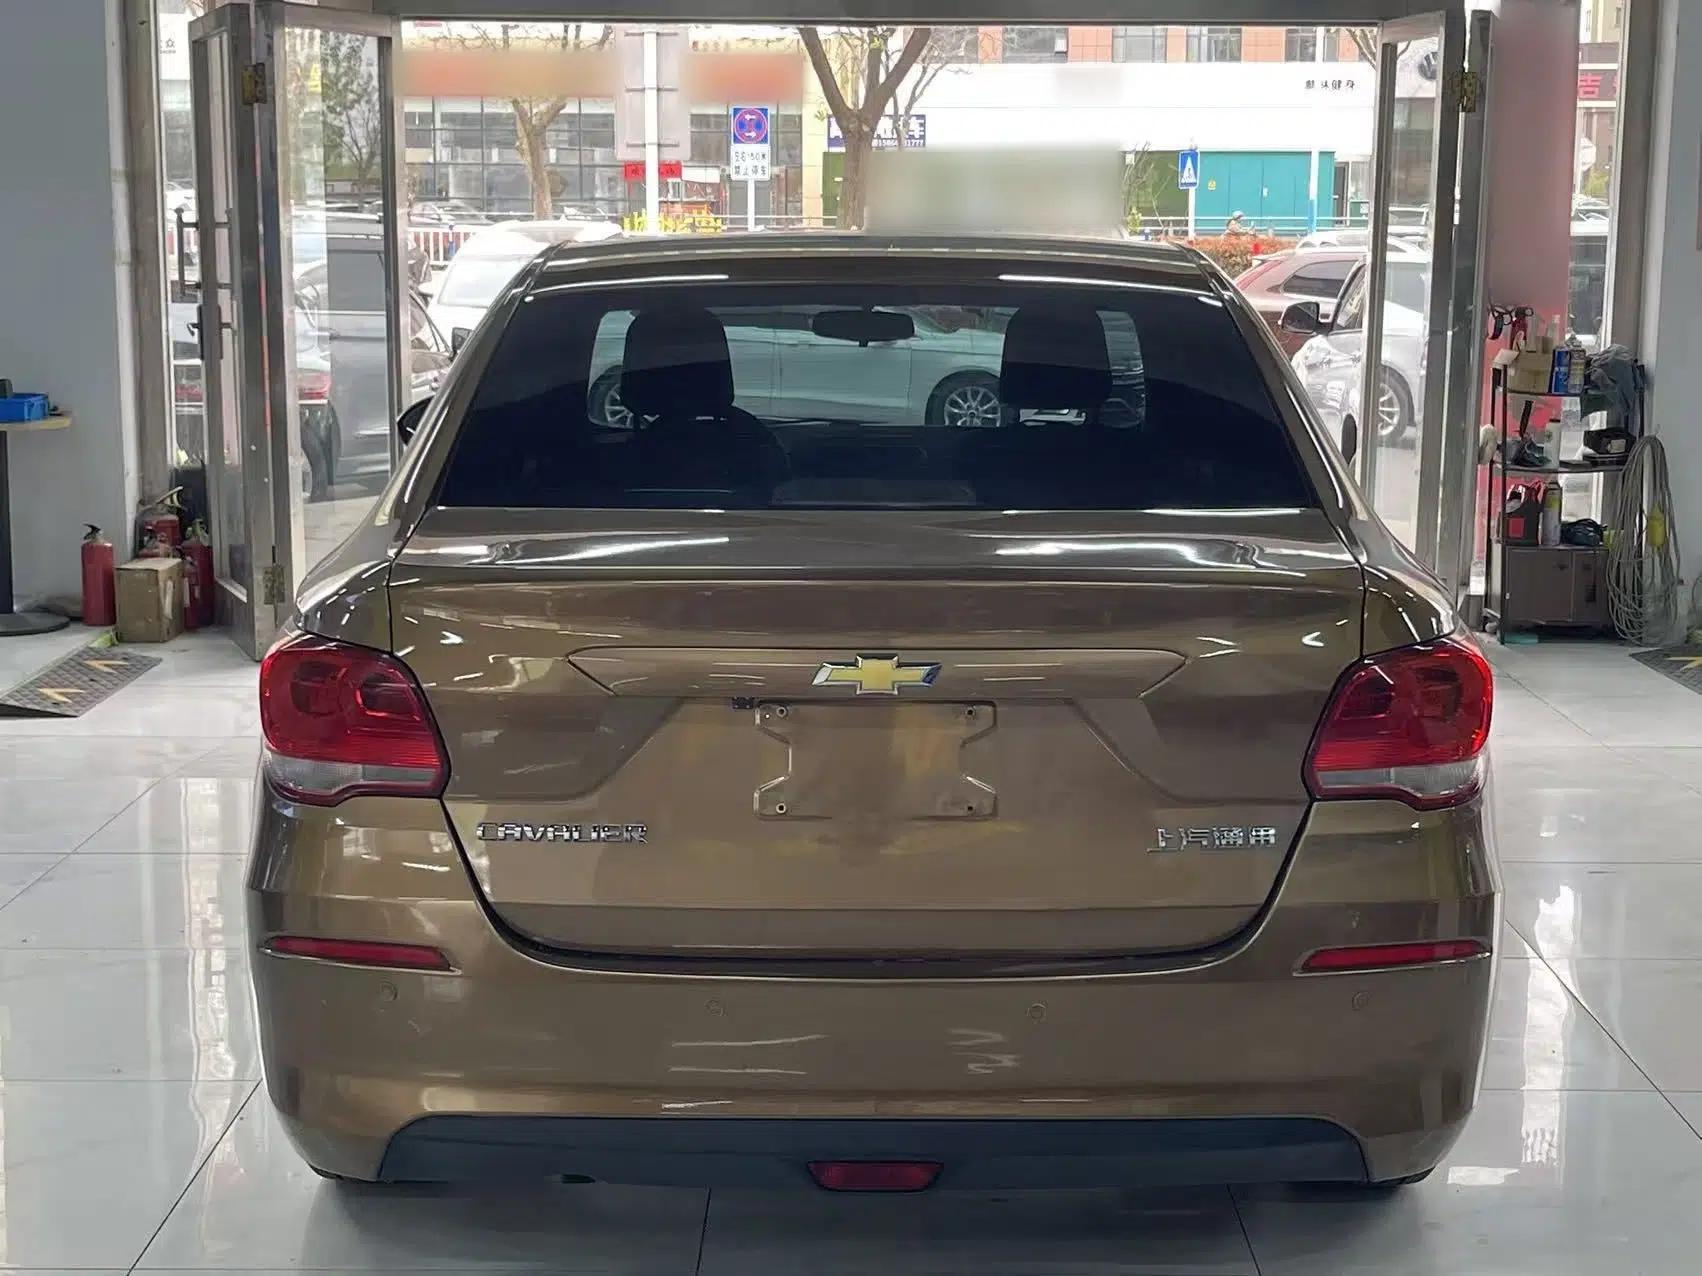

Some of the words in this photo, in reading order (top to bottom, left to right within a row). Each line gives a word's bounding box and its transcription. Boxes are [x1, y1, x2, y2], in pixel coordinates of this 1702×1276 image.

[476, 822, 649, 844] CAVALIER
[1146, 826, 1277, 853] 上汽通用
